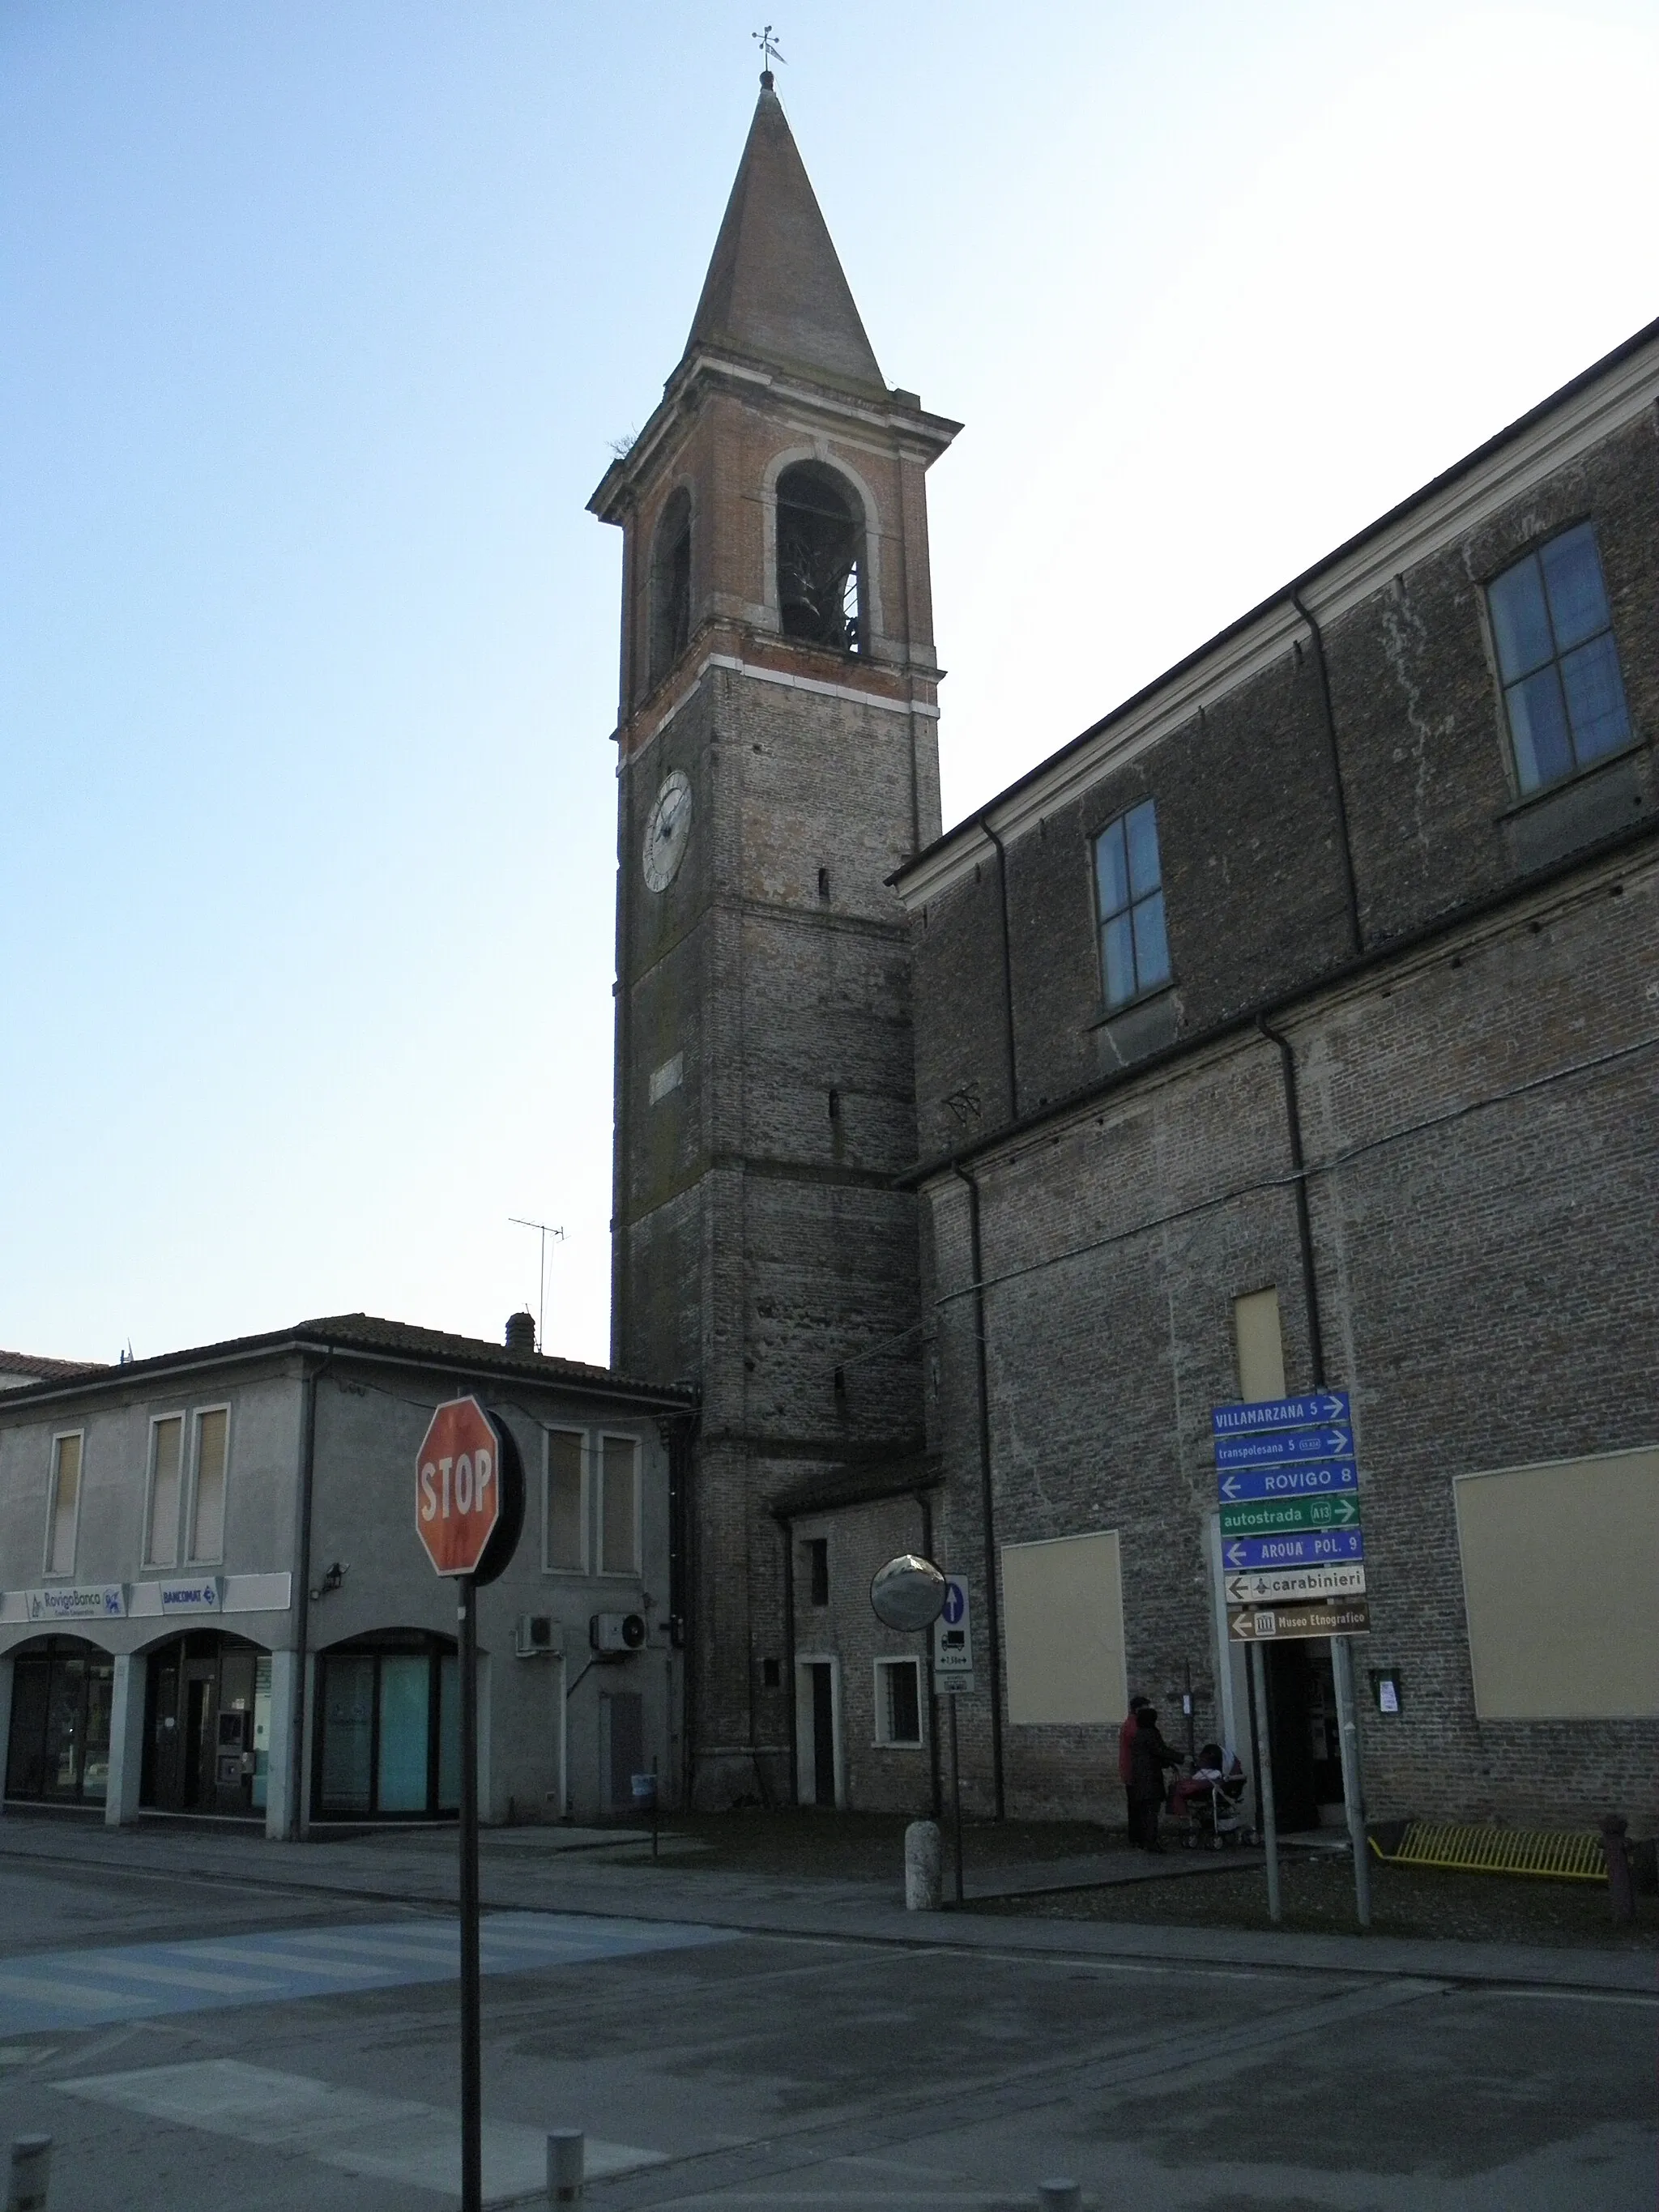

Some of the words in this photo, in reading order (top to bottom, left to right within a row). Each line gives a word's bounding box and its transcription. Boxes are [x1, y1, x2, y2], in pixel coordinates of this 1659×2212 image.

[1216, 1404, 1304, 1428] VILLAMARZANA
[1310, 1402, 1318, 1415] 5
[1219, 1443, 1283, 1459] transpolesana
[1289, 1440, 1295, 1451] 5
[421, 1448, 492, 1522] STOP
[1265, 1471, 1331, 1490] ROVIGO
[1341, 1468, 1352, 1482] 8
[1224, 1508, 1303, 1527] autostrada
[1313, 1507, 1330, 1519] A13
[1315, 1538, 1341, 1554] POL.
[1349, 1536, 1357, 1550] 9
[1273, 1571, 1360, 1592] carabinieri
[45, 1591, 100, 1609] RovigoBanca
[163, 1590, 201, 1604] BANCOMAT
[1278, 1617, 1307, 1628] Museo
[1310, 1613, 1364, 1627] Etnografico
